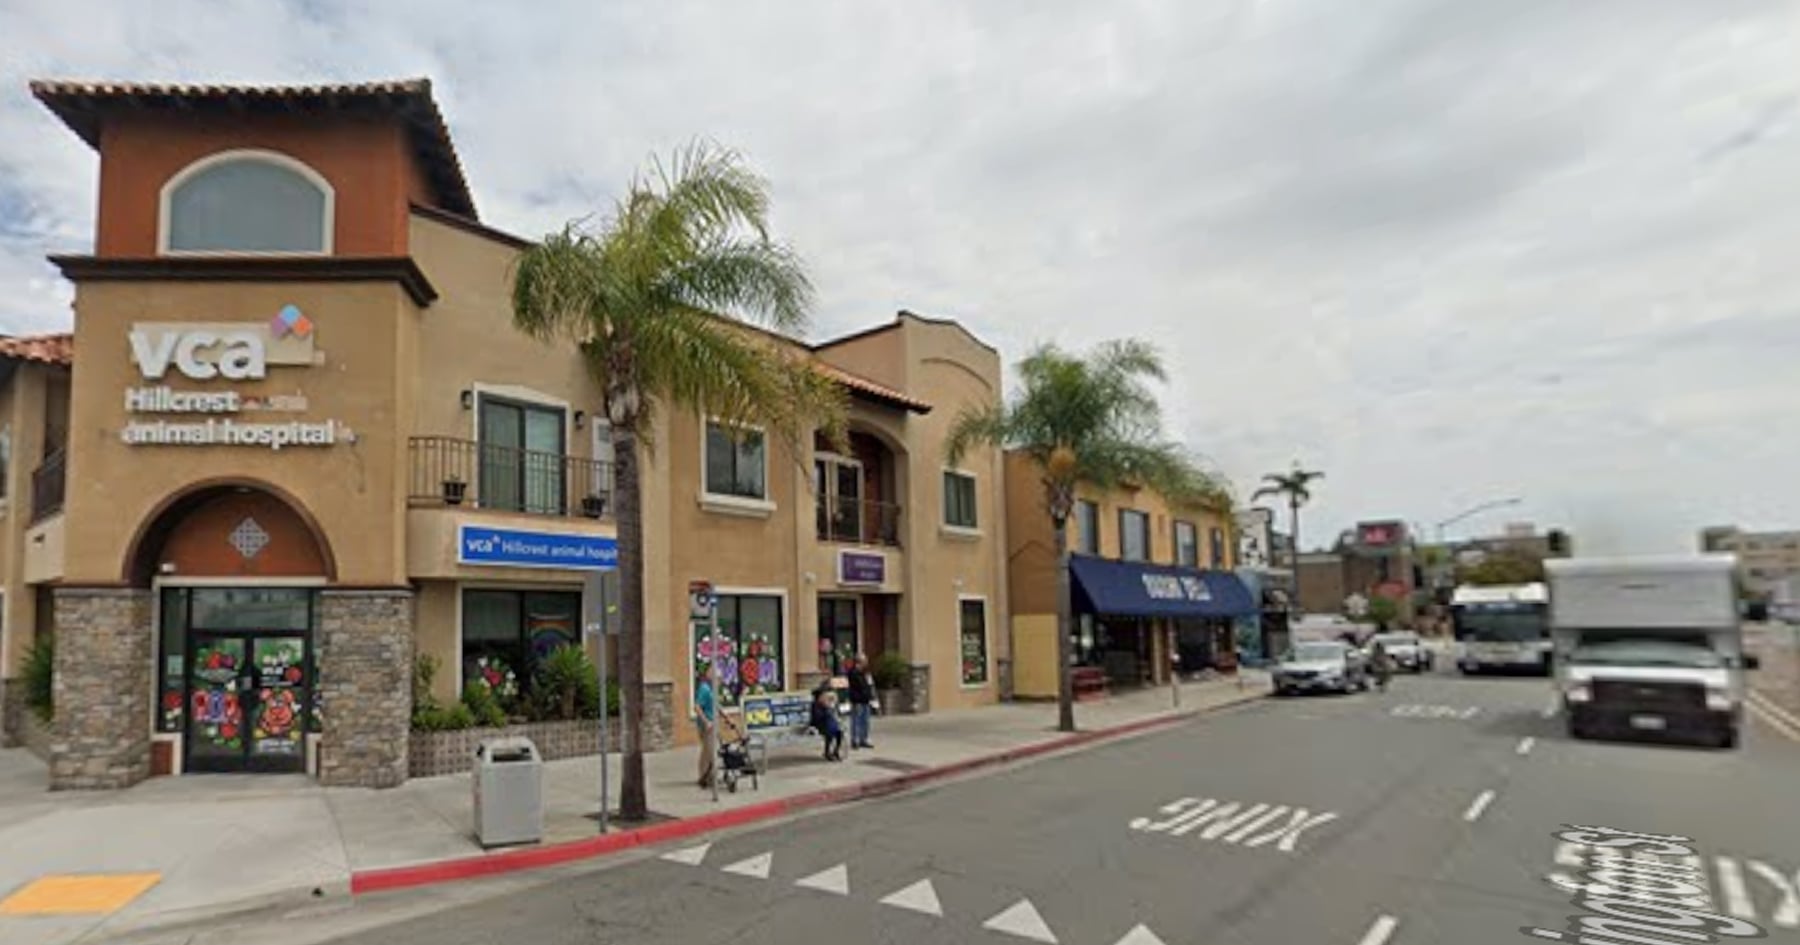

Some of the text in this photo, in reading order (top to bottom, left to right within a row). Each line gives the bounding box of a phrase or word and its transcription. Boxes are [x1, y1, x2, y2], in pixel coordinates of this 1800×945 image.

[128, 328, 265, 379] vca
[125, 386, 239, 413] Hillcrest
[121, 418, 335, 450] animal hospital
[466, 538, 493, 552] vca
[501, 540, 548, 556] Hillcrest
[551, 544, 585, 558] animal
[1129, 797, 1339, 851] XING
